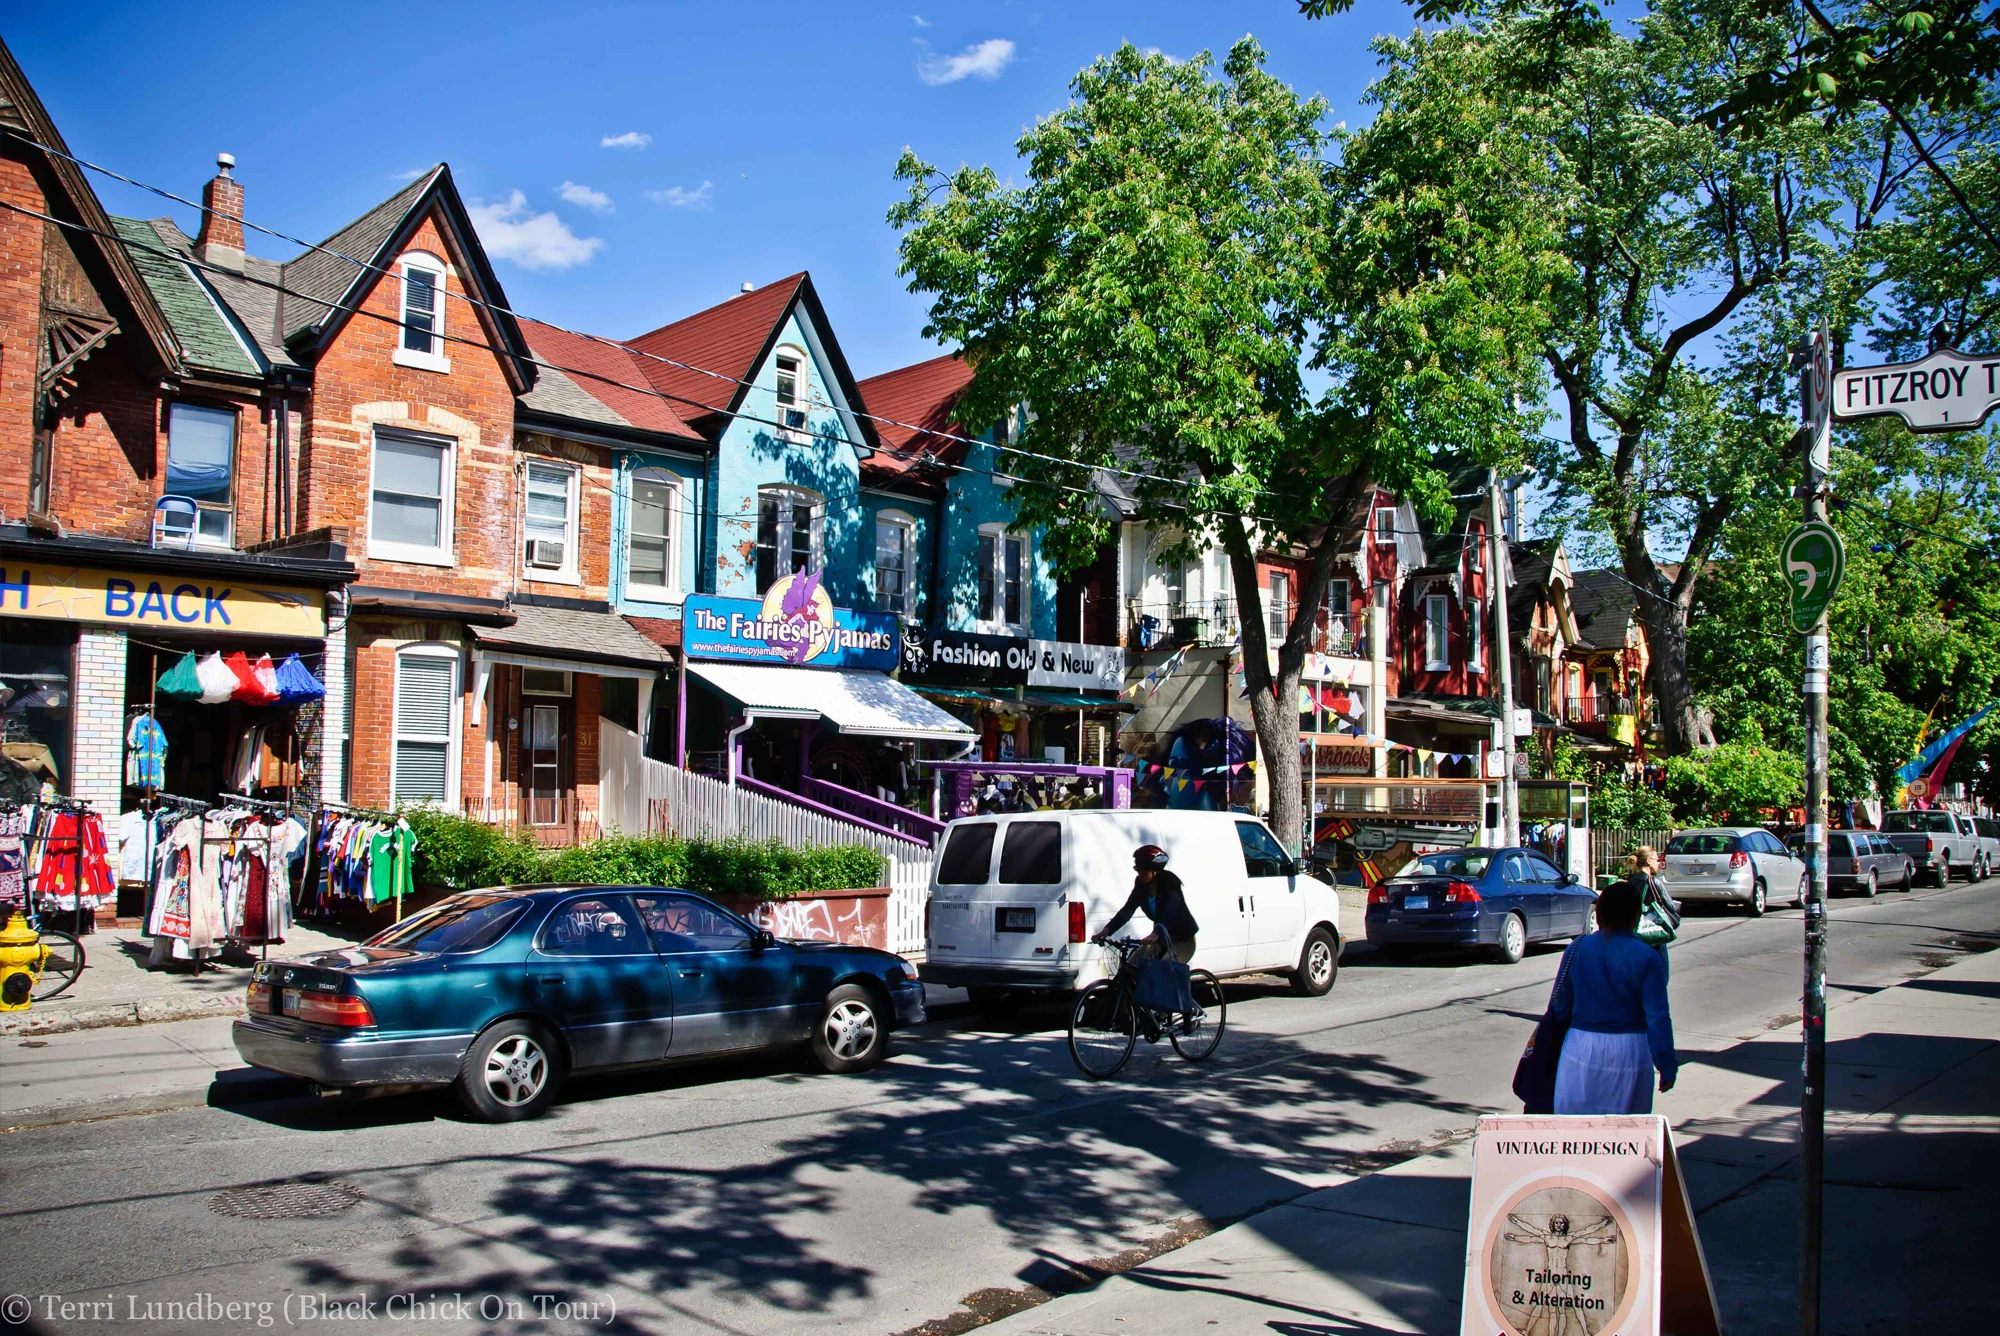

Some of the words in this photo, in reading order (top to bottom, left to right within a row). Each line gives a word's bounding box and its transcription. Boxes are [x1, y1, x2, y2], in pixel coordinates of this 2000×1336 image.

[1846, 364, 1970, 408] FITZROY
[1941, 410, 1949, 423] 1
[0, 567, 31, 610] H
[104, 577, 233, 626] BACK
[693, 609, 727, 632] The
[730, 612, 802, 643] Fairies
[808, 620, 892, 654] Pyjamas
[692, 642, 795, 658] www.thefairiespyjamas.com
[932, 639, 1001, 668] Fashion
[1006, 647, 1037, 671] Old
[1042, 651, 1055, 672] &
[1061, 652, 1095, 675] New
[579, 732, 593, 746] 31
[1496, 1141, 1558, 1156] VINTAGE
[1562, 1140, 1639, 1156] REDESIGN
[1525, 1268, 1592, 1290] Tailoring
[1511, 1290, 1525, 1305] &
[1529, 1289, 1605, 1310] Alteration
